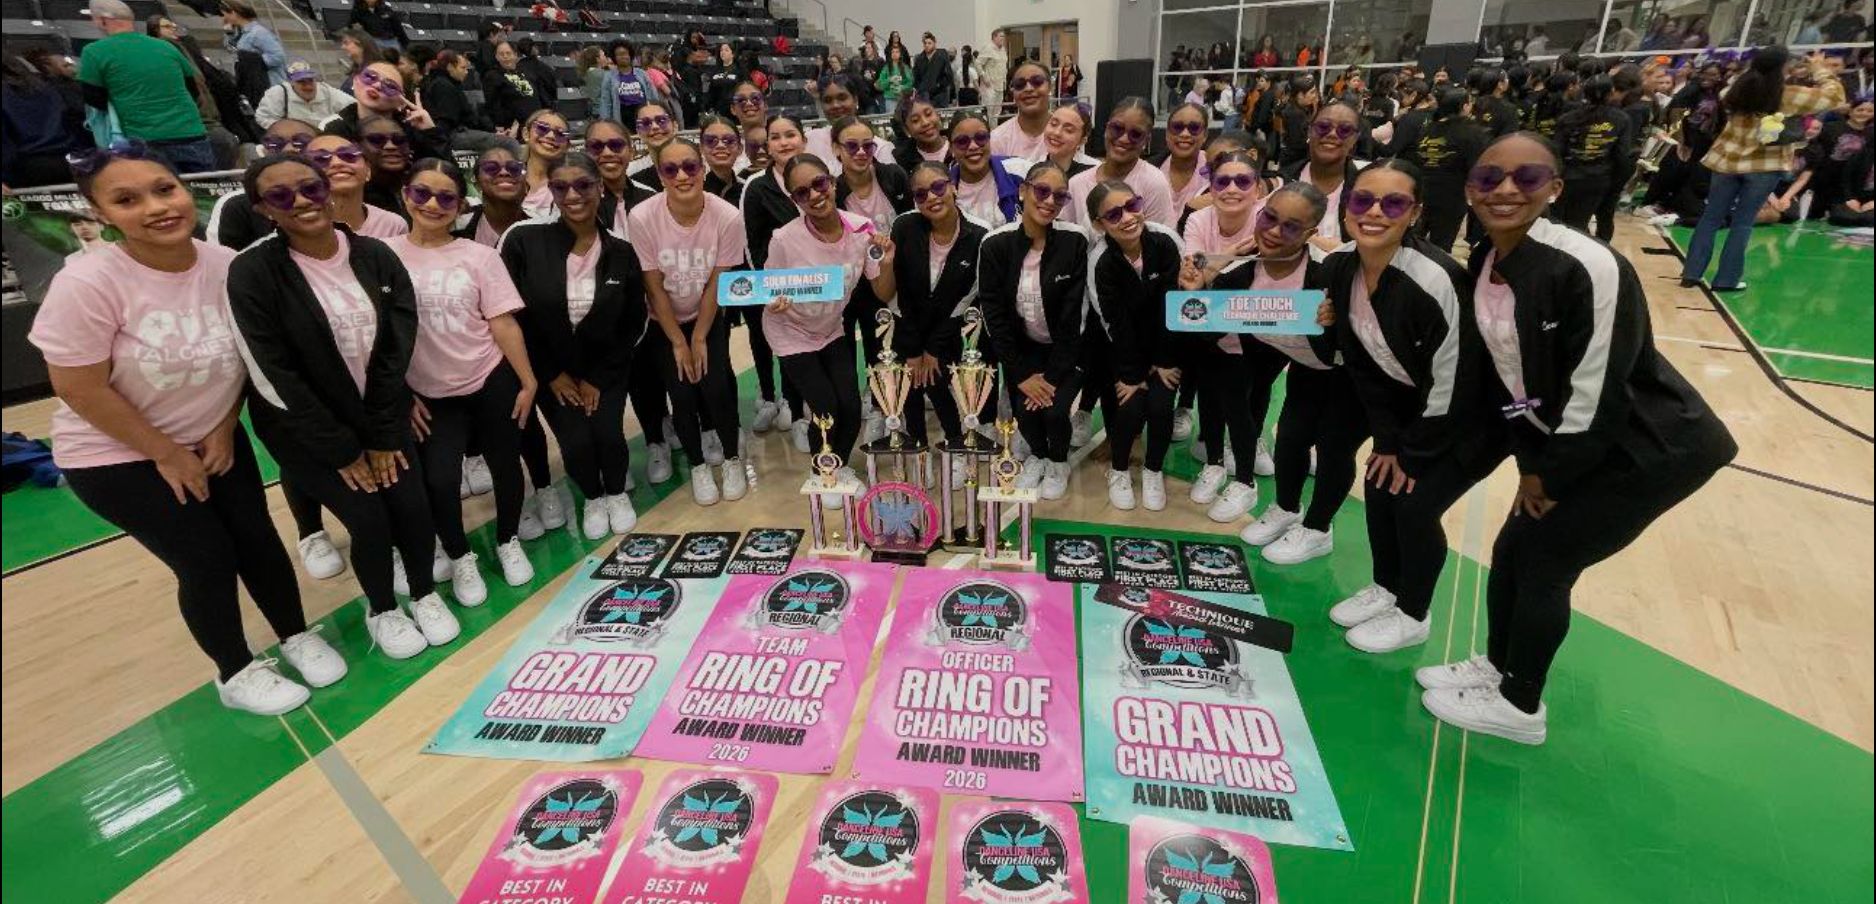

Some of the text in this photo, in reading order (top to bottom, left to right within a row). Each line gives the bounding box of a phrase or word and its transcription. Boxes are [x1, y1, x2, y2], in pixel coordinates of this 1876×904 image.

[1253, 296, 1293, 310] TOUCH
[769, 612, 820, 626] REGIONAL
[1169, 600, 1255, 630] TECHNIQUE
[757, 637, 808, 656] TEAM
[951, 627, 1006, 640] REGIONAL
[510, 653, 655, 694] GRAND
[943, 652, 1014, 672] OFFICER
[689, 653, 842, 698] RING OF
[1197, 670, 1231, 684] STATE
[898, 669, 1050, 717] RING OF
[485, 692, 634, 722] CHAMPIONS
[680, 691, 822, 725] CHAMPIONS
[475, 721, 606, 745] AWARD WINNER
[673, 718, 806, 746] AWARD WINNER
[896, 711, 1048, 746] CHAMPIONS
[1117, 699, 1283, 757] GRAND
[709, 743, 749, 761] 2026
[897, 742, 1040, 772] AWARD WINNER
[944, 770, 986, 789] 2026
[1117, 746, 1296, 793] CHAMPIONS
[1132, 783, 1294, 821] AWARD WINNER
[886, 827, 903, 837] USA
[500, 879, 567, 895] BEST IN
[643, 878, 709, 896] BEST IN
